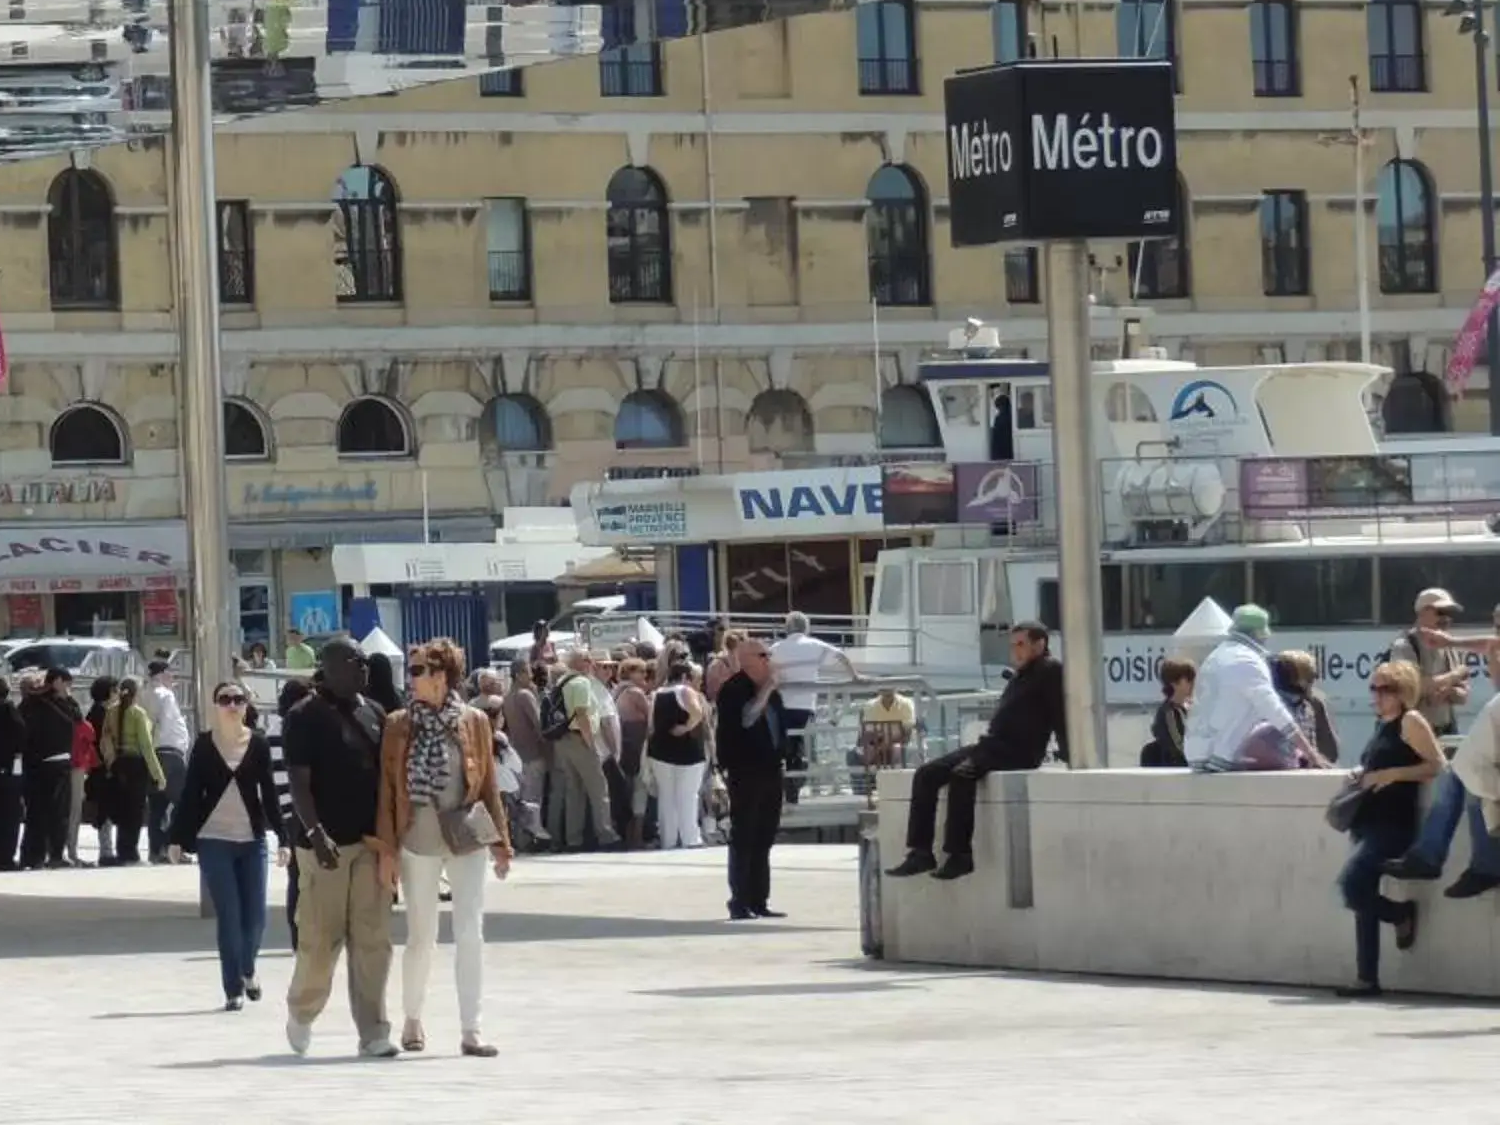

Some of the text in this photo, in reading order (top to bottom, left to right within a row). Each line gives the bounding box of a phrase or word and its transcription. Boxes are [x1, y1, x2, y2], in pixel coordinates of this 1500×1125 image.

[951, 118, 1012, 179] Métro
[1032, 112, 1163, 170] Métro
[21, 481, 116, 505] ITALIA
[628, 502, 686, 513] MARSEILLE
[628, 514, 686, 523] PROVENCE
